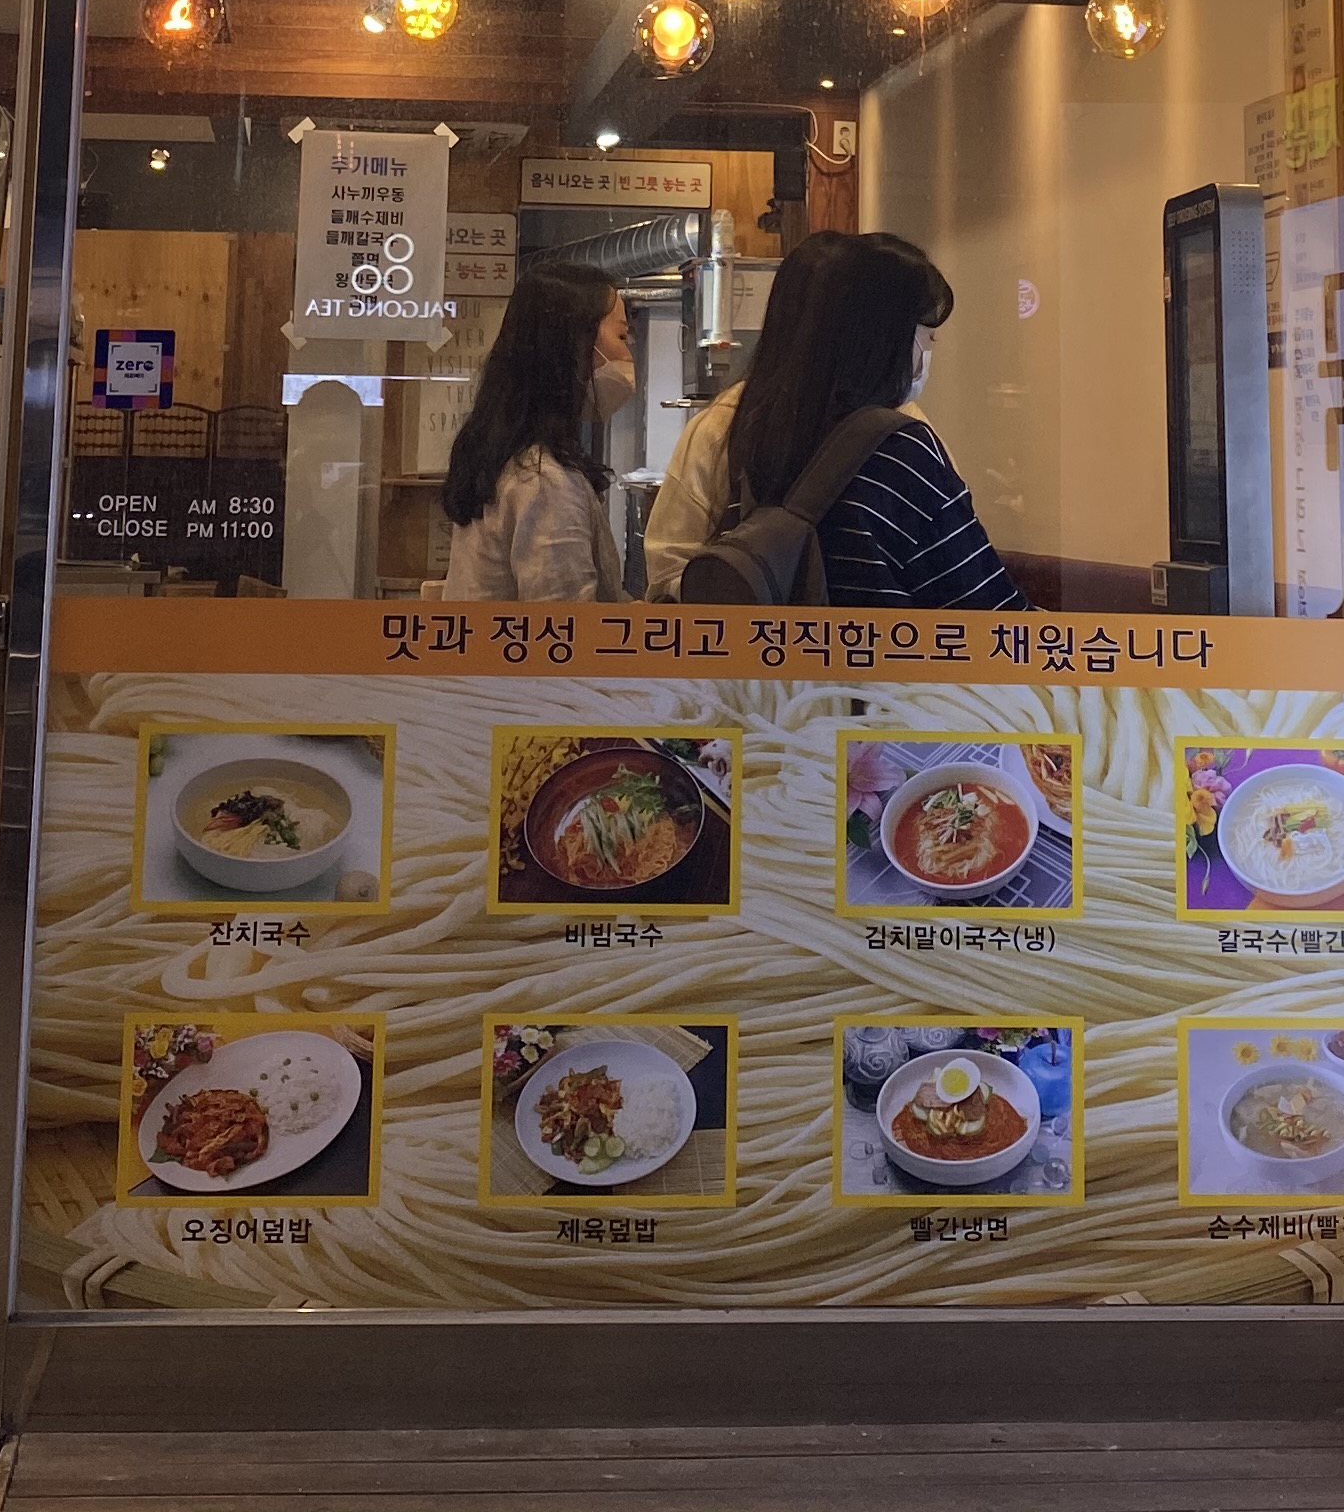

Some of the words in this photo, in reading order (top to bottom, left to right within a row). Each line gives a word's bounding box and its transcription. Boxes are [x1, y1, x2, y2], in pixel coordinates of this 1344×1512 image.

[330, 155, 408, 177] 추가메뉴
[331, 185, 405, 203] 사누끼우동
[530, 173, 554, 189] 음식
[559, 173, 594, 190] 나오는
[597, 175, 610, 190] 곳
[618, 176, 631, 191] 빈
[634, 176, 658, 192] 그릇
[662, 177, 686, 193] 놓는
[689, 178, 702, 193] 곳
[331, 209, 404, 226] 들깨수제비
[115, 359, 155, 373] zero
[98, 495, 157, 512] OPEN
[187, 499, 217, 515] AM
[228, 496, 275, 515] 8:30
[97, 519, 168, 537] CLOSE
[186, 522, 214, 538] PM
[220, 520, 274, 539] 11:00
[380, 611, 474, 662] 맛과
[488, 614, 577, 664] 정성
[594, 616, 731, 659] 그리고
[747, 618, 972, 671] 정직함으로
[988, 622, 1214, 675] 채웠습니다
[208, 919, 312, 949] 잔치국수
[563, 921, 664, 950] 비빔국수
[863, 922, 1057, 955] 김치말이국수(냉)
[180, 1216, 313, 1246] 오징어덮밥
[556, 1216, 658, 1245] 제육덮밥
[909, 1213, 1010, 1244] 빨간냉면
